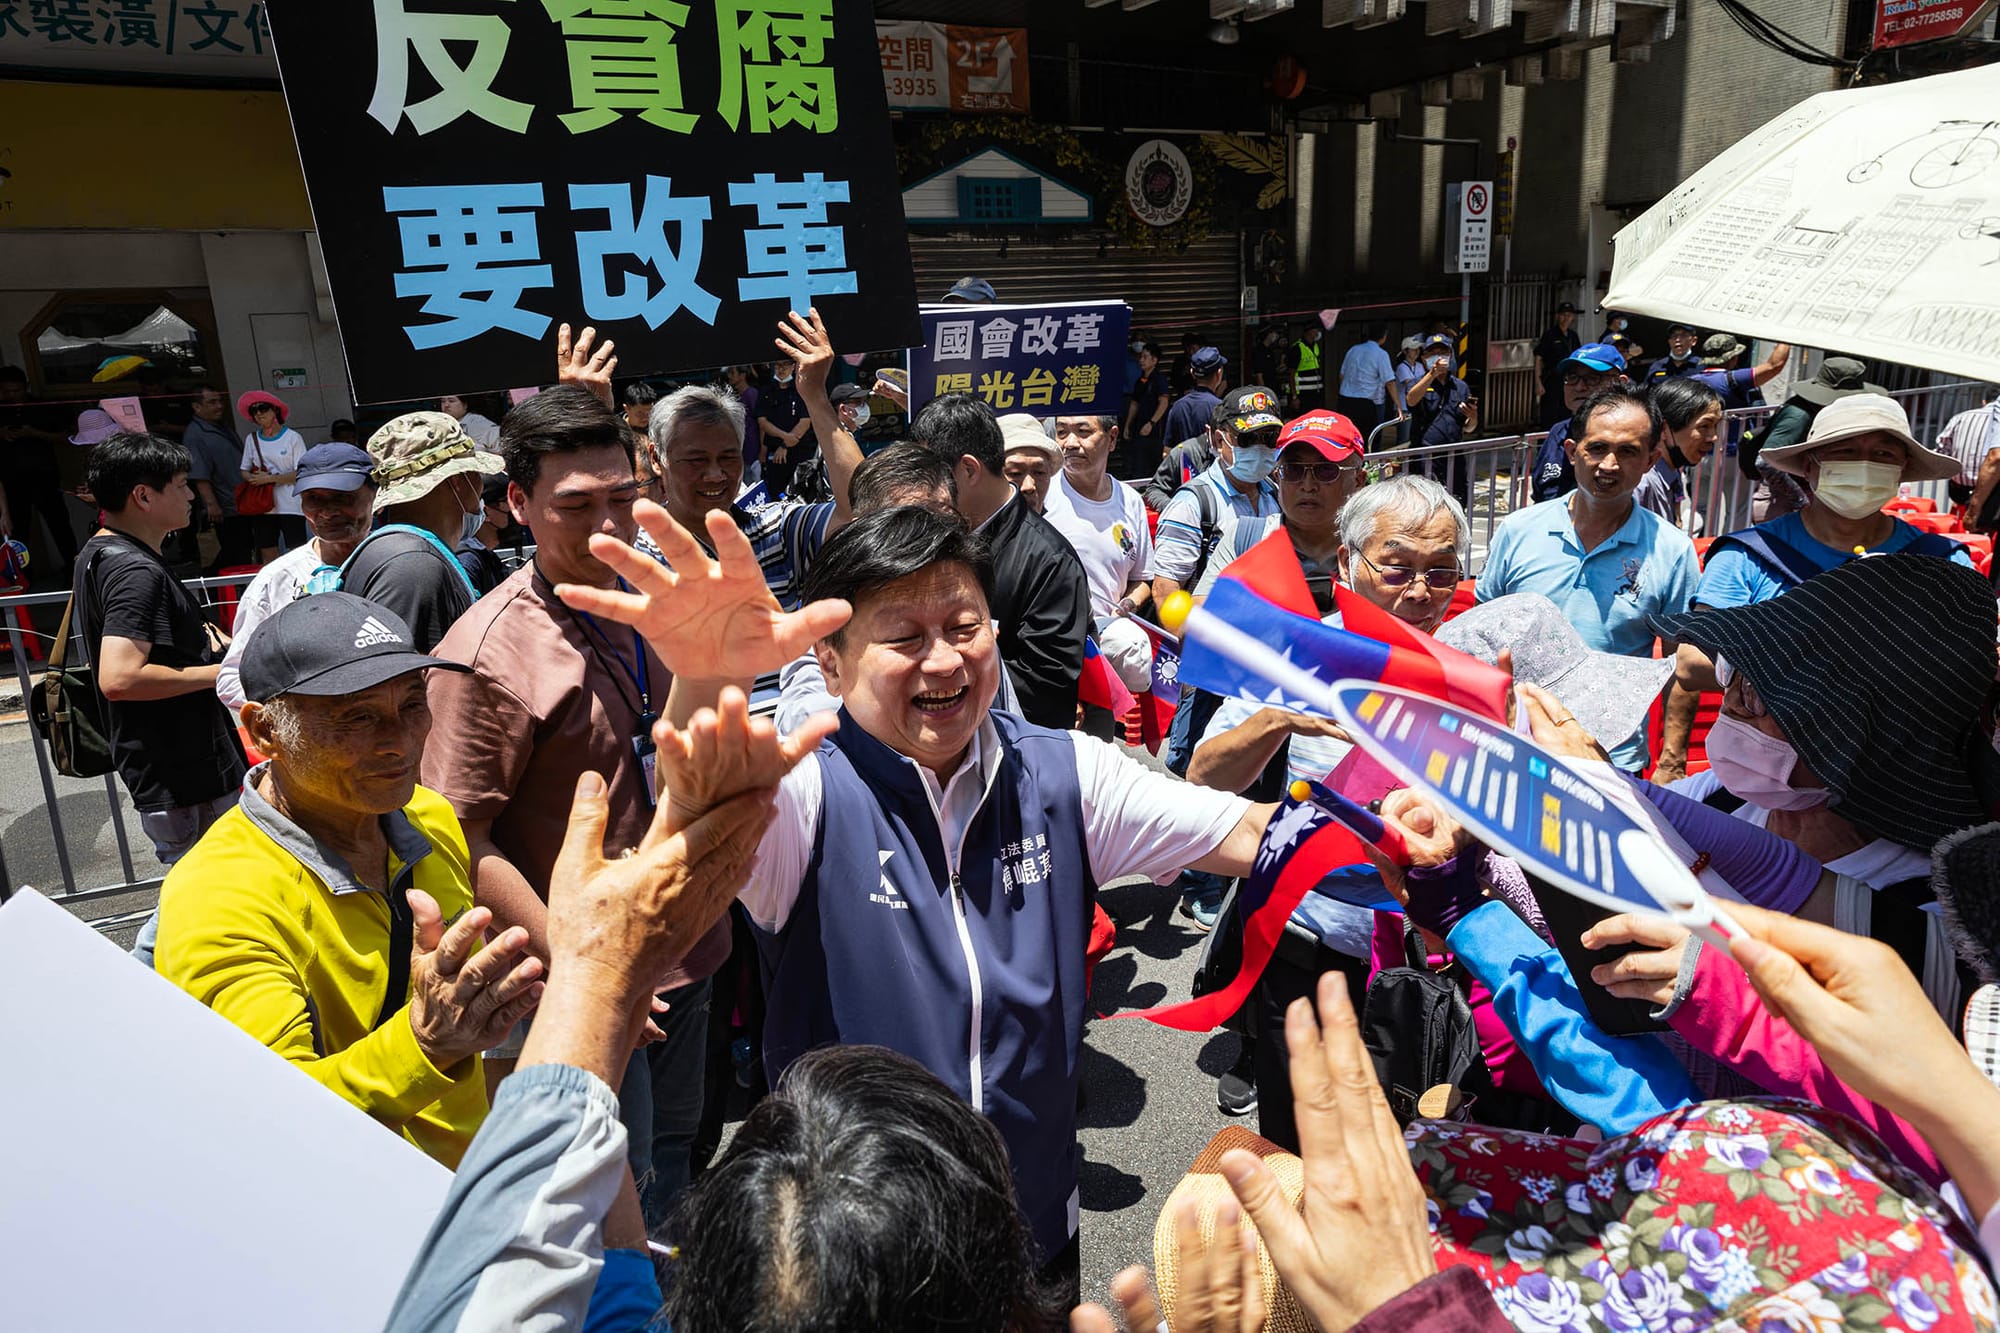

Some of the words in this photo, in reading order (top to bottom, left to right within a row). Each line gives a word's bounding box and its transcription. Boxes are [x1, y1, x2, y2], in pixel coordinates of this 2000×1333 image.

[1883, 0, 1917, 16] Rich
[366, 0, 840, 136] 反貪腐
[878, 35, 934, 72] 空間
[956, 40, 992, 68] 2F
[382, 172, 859, 350] 要改革
[933, 313, 1105, 362] 國會改革
[354, 632, 403, 649] adidas
